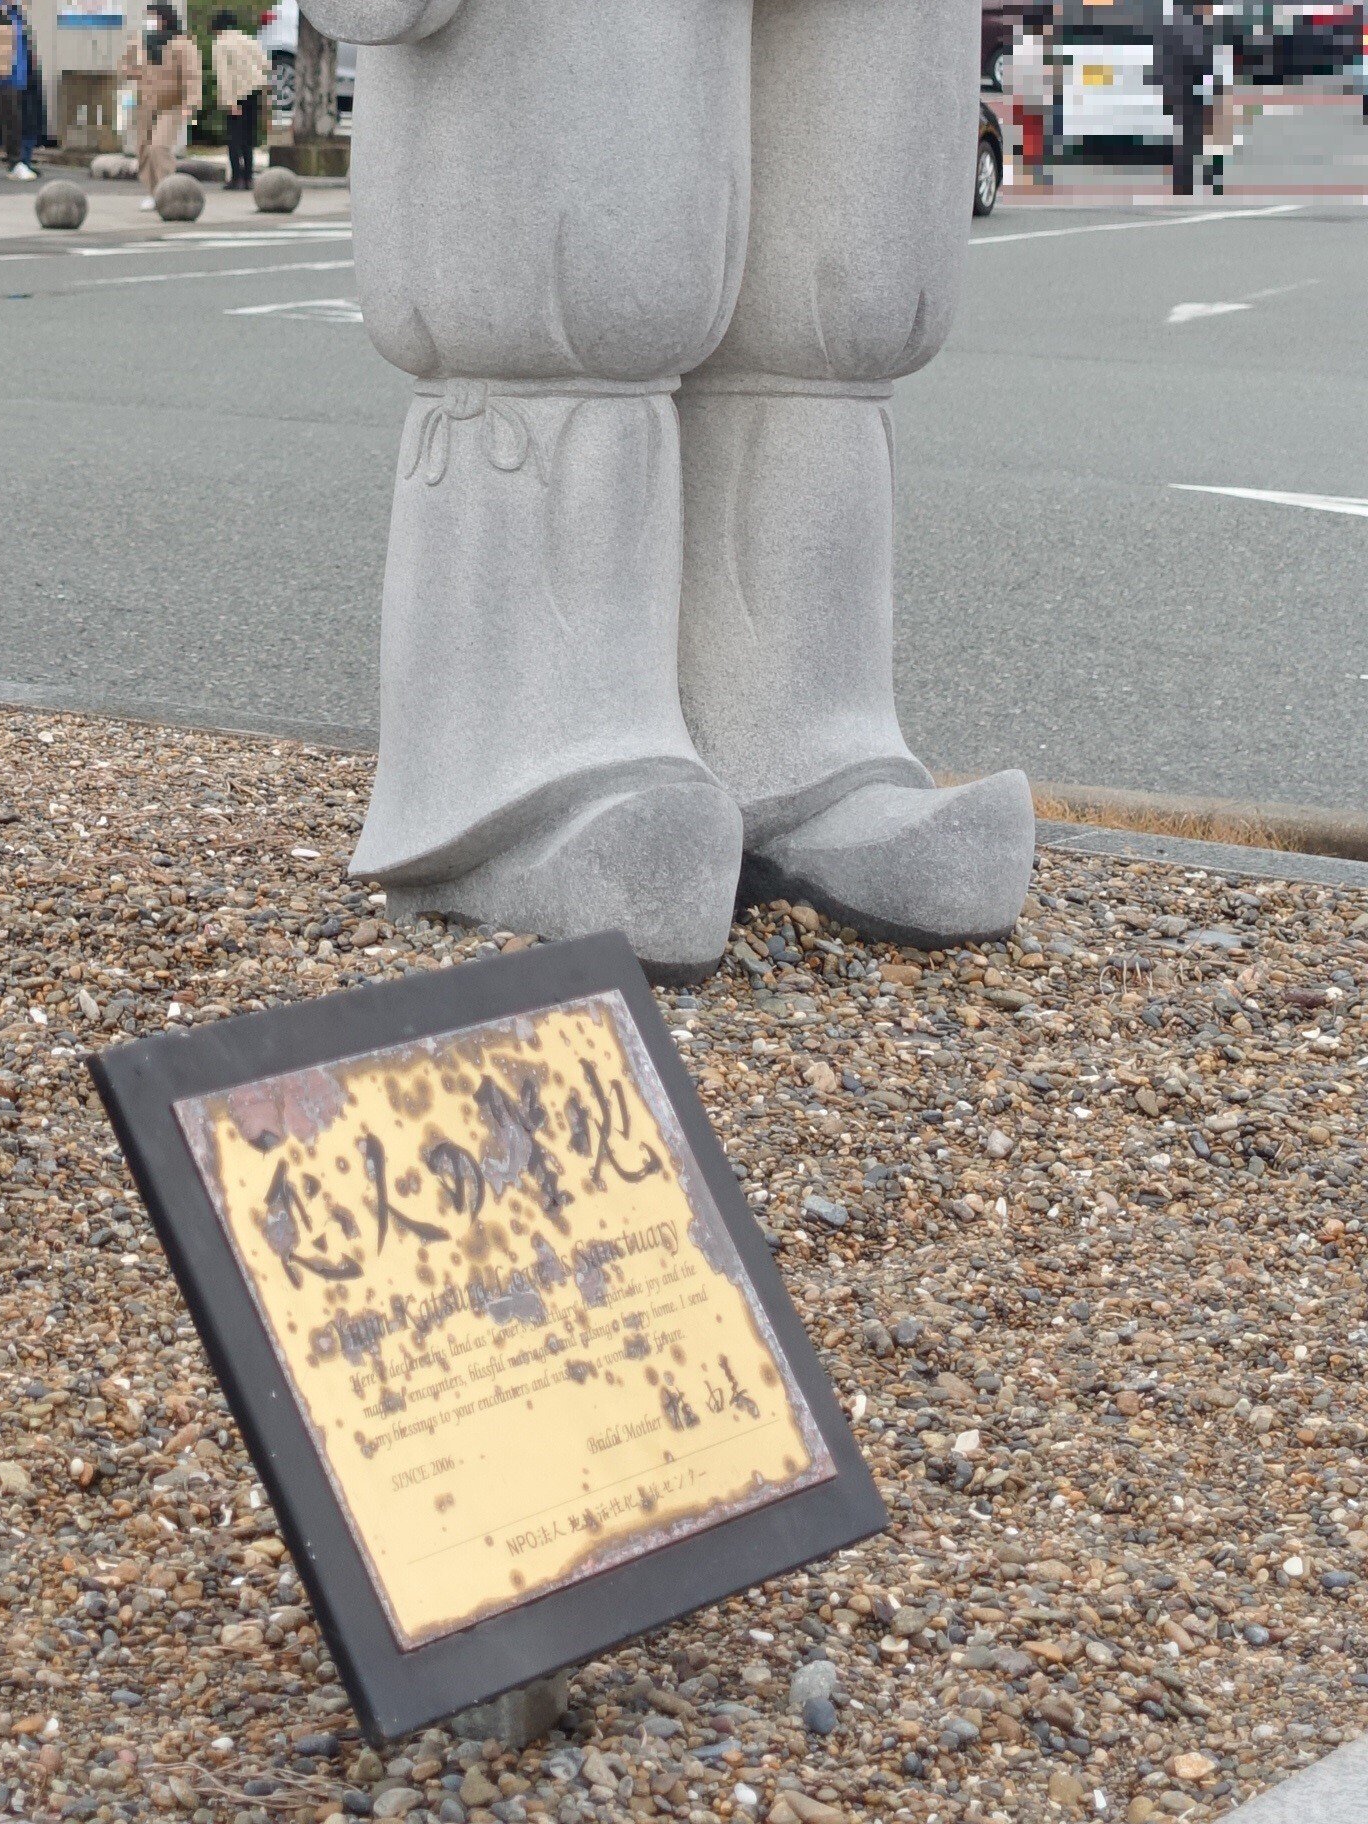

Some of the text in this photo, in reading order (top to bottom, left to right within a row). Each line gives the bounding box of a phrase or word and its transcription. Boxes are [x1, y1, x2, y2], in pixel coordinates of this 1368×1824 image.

[409, 1373, 468, 1402] encounters,
[467, 1352, 507, 1381] blissful
[650, 1300, 678, 1318] home.
[687, 1283, 709, 1306] send
[447, 1333, 473, 1357] land
[473, 1334, 485, 1349] as
[641, 1276, 662, 1297] joy
[661, 1264, 681, 1285] and
[680, 1260, 696, 1279] the
[391, 1414, 438, 1441] blessings
[437, 1408, 451, 1425] to
[451, 1401, 476, 1425] your
[476, 1382, 530, 1411] encounters
[530, 1369, 551, 1392] and
[586, 1425, 621, 1455] Bridal
[621, 1414, 663, 1441] Mother
[389, 1454, 455, 1492] SINCE 2006
